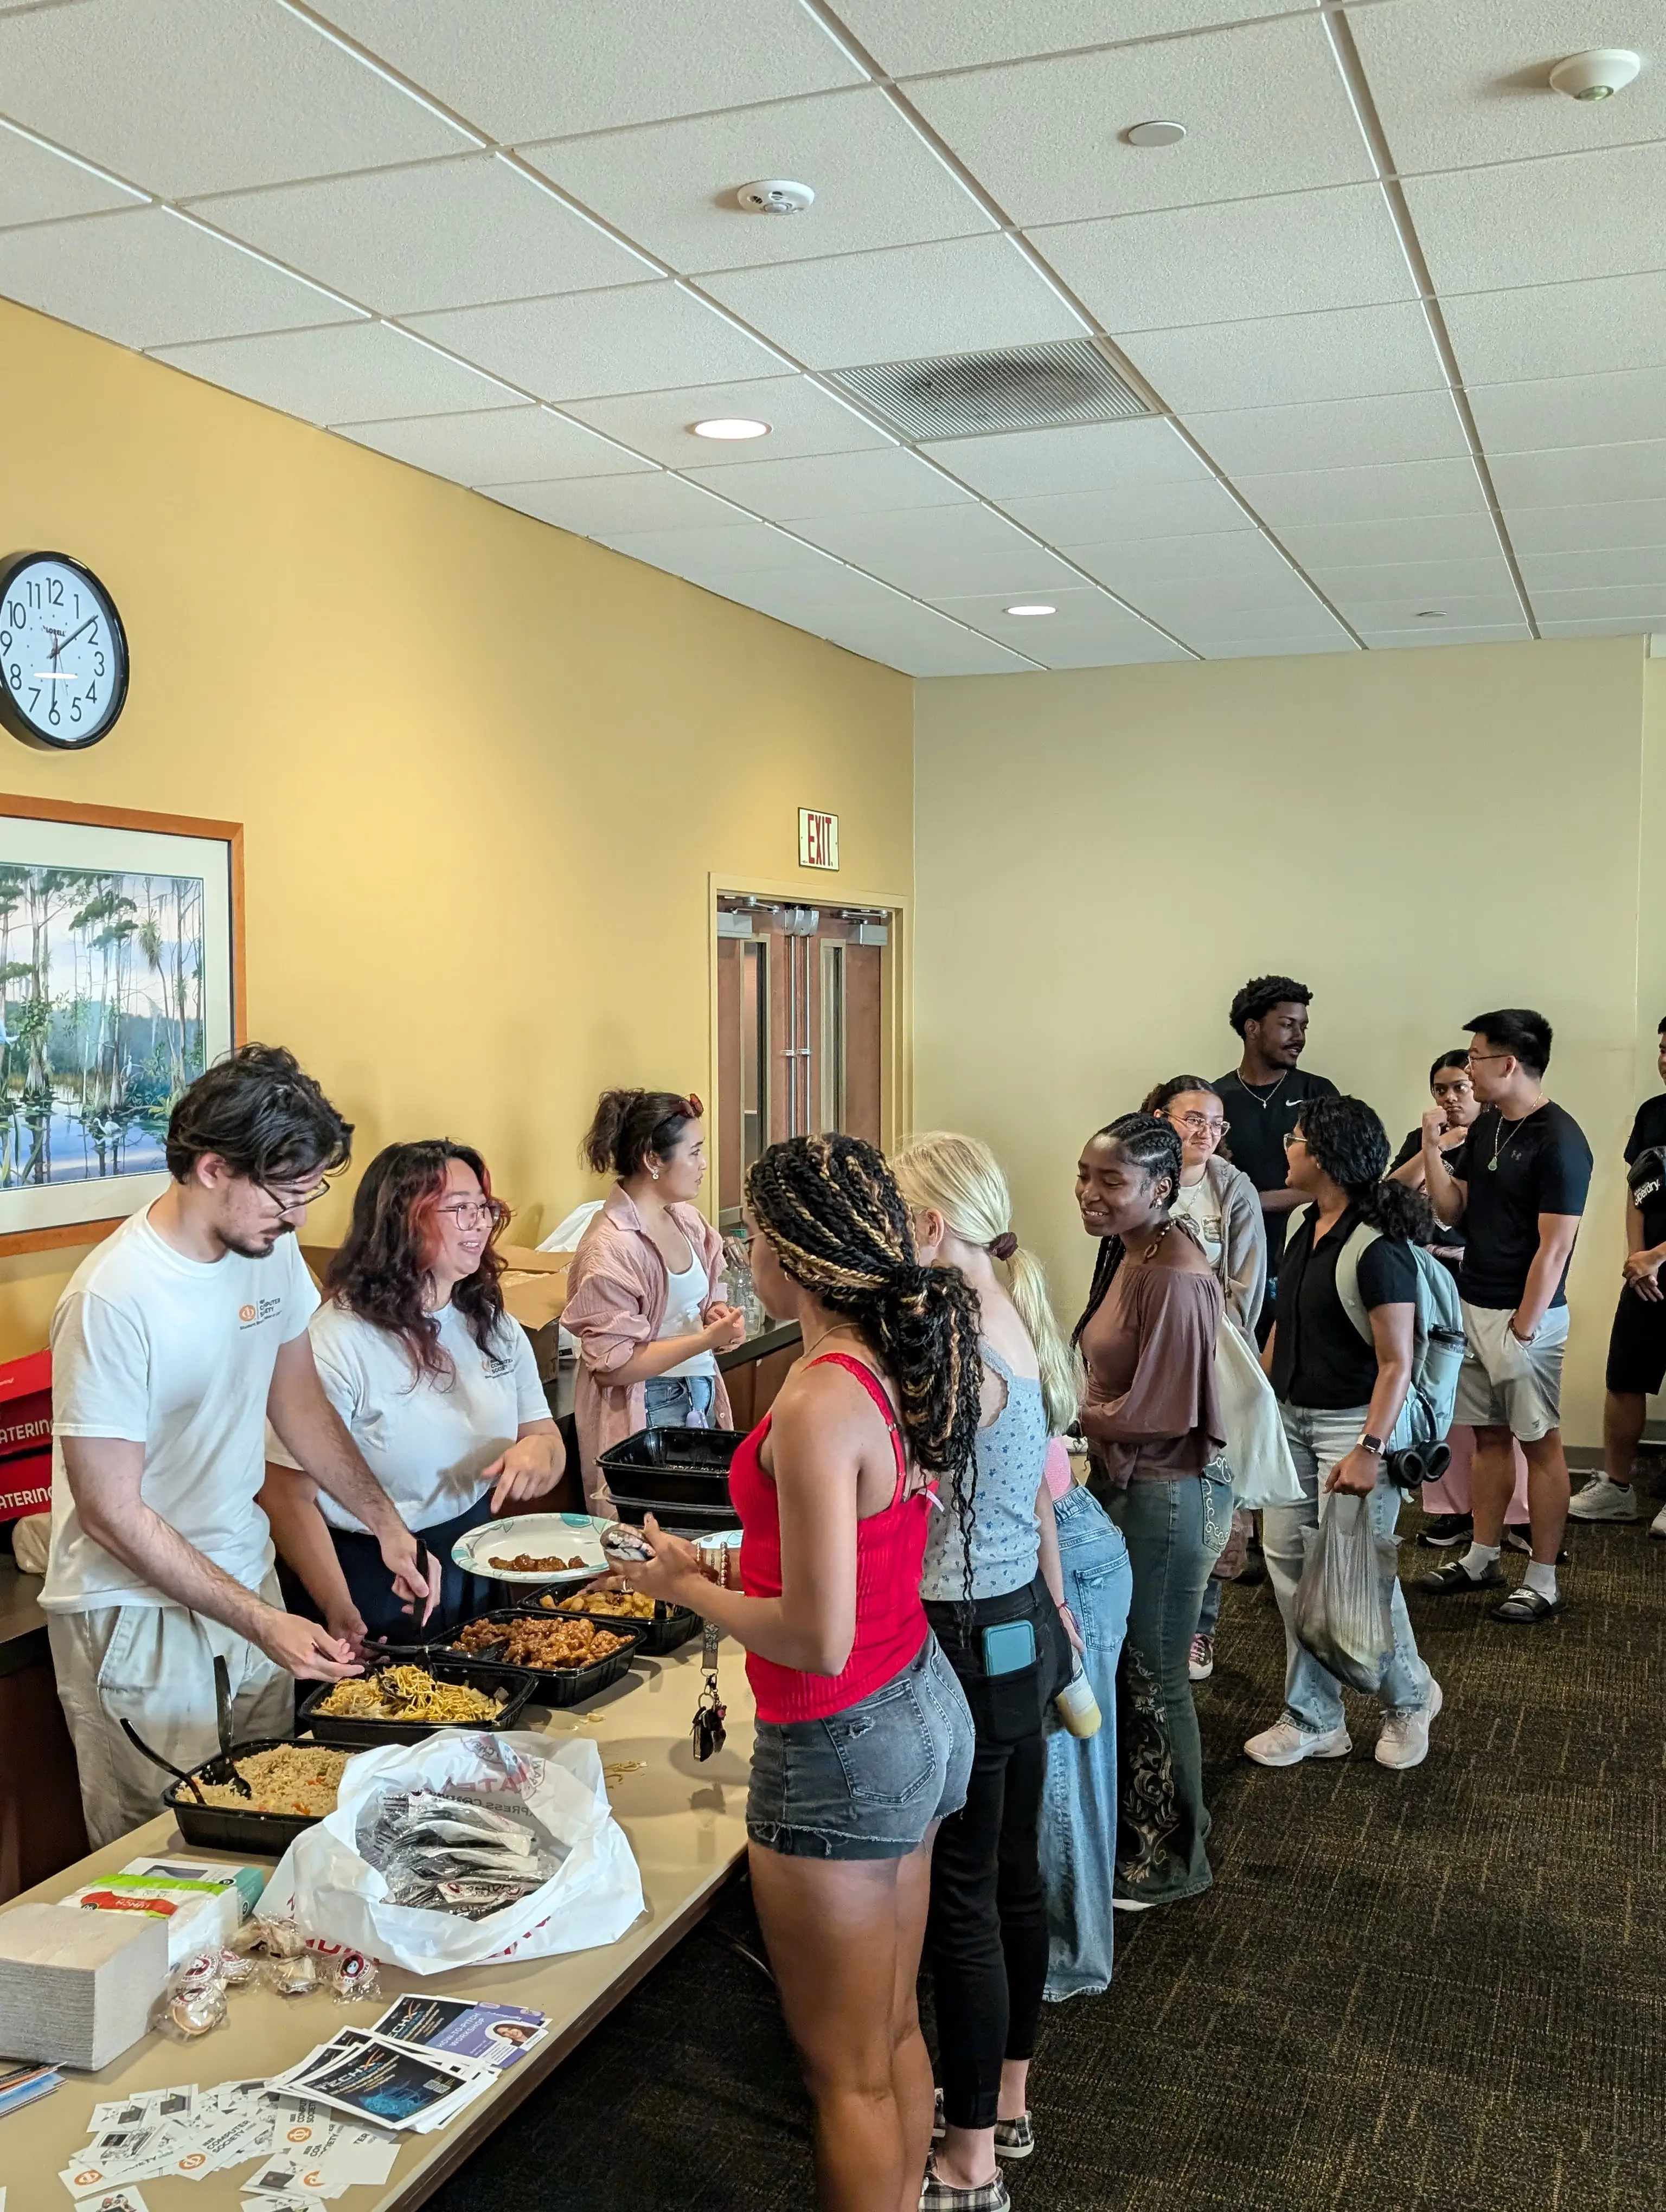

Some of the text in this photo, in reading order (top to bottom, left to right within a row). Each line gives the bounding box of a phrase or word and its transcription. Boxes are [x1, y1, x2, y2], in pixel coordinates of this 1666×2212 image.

[26, 581, 41, 609] 11
[46, 577, 64, 607] 12
[7, 600, 27, 629] 10
[74, 594, 79, 619] 1
[0, 630, 12, 657] 9
[87, 619, 99, 646] 2
[10, 663, 22, 691] 8
[94, 651, 105, 677] 3
[28, 687, 42, 713] 7
[85, 679, 98, 704] 4
[48, 700, 61, 726] 6
[70, 697, 81, 722] 5
[807, 813, 832, 866] EXIT
[259, 1297, 280, 1311] CPUTER
[0, 1419, 53, 1443] ATERIN
[435, 2012, 482, 2048] HOW-TO-PITCH
[448, 2017, 485, 2047] WORKSHOP
[207, 2119, 249, 2150] COMPUTER
[212, 2130, 245, 2153] SOCIETY
